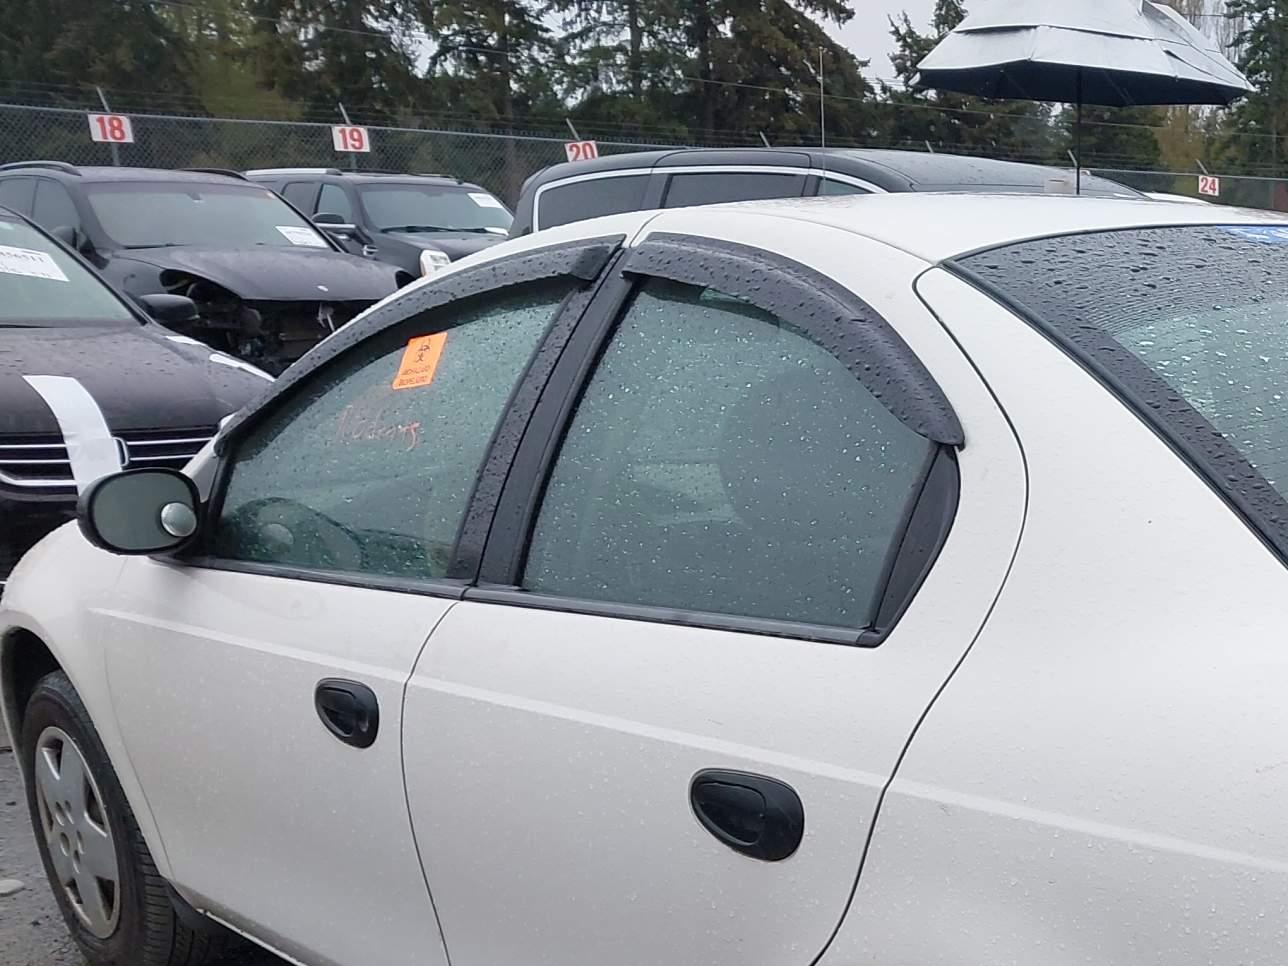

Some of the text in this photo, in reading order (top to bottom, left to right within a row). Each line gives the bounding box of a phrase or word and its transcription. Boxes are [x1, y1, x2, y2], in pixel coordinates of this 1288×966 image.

[95, 115, 127, 142] 18
[338, 126, 365, 150] 19
[1199, 177, 1218, 195] 24
